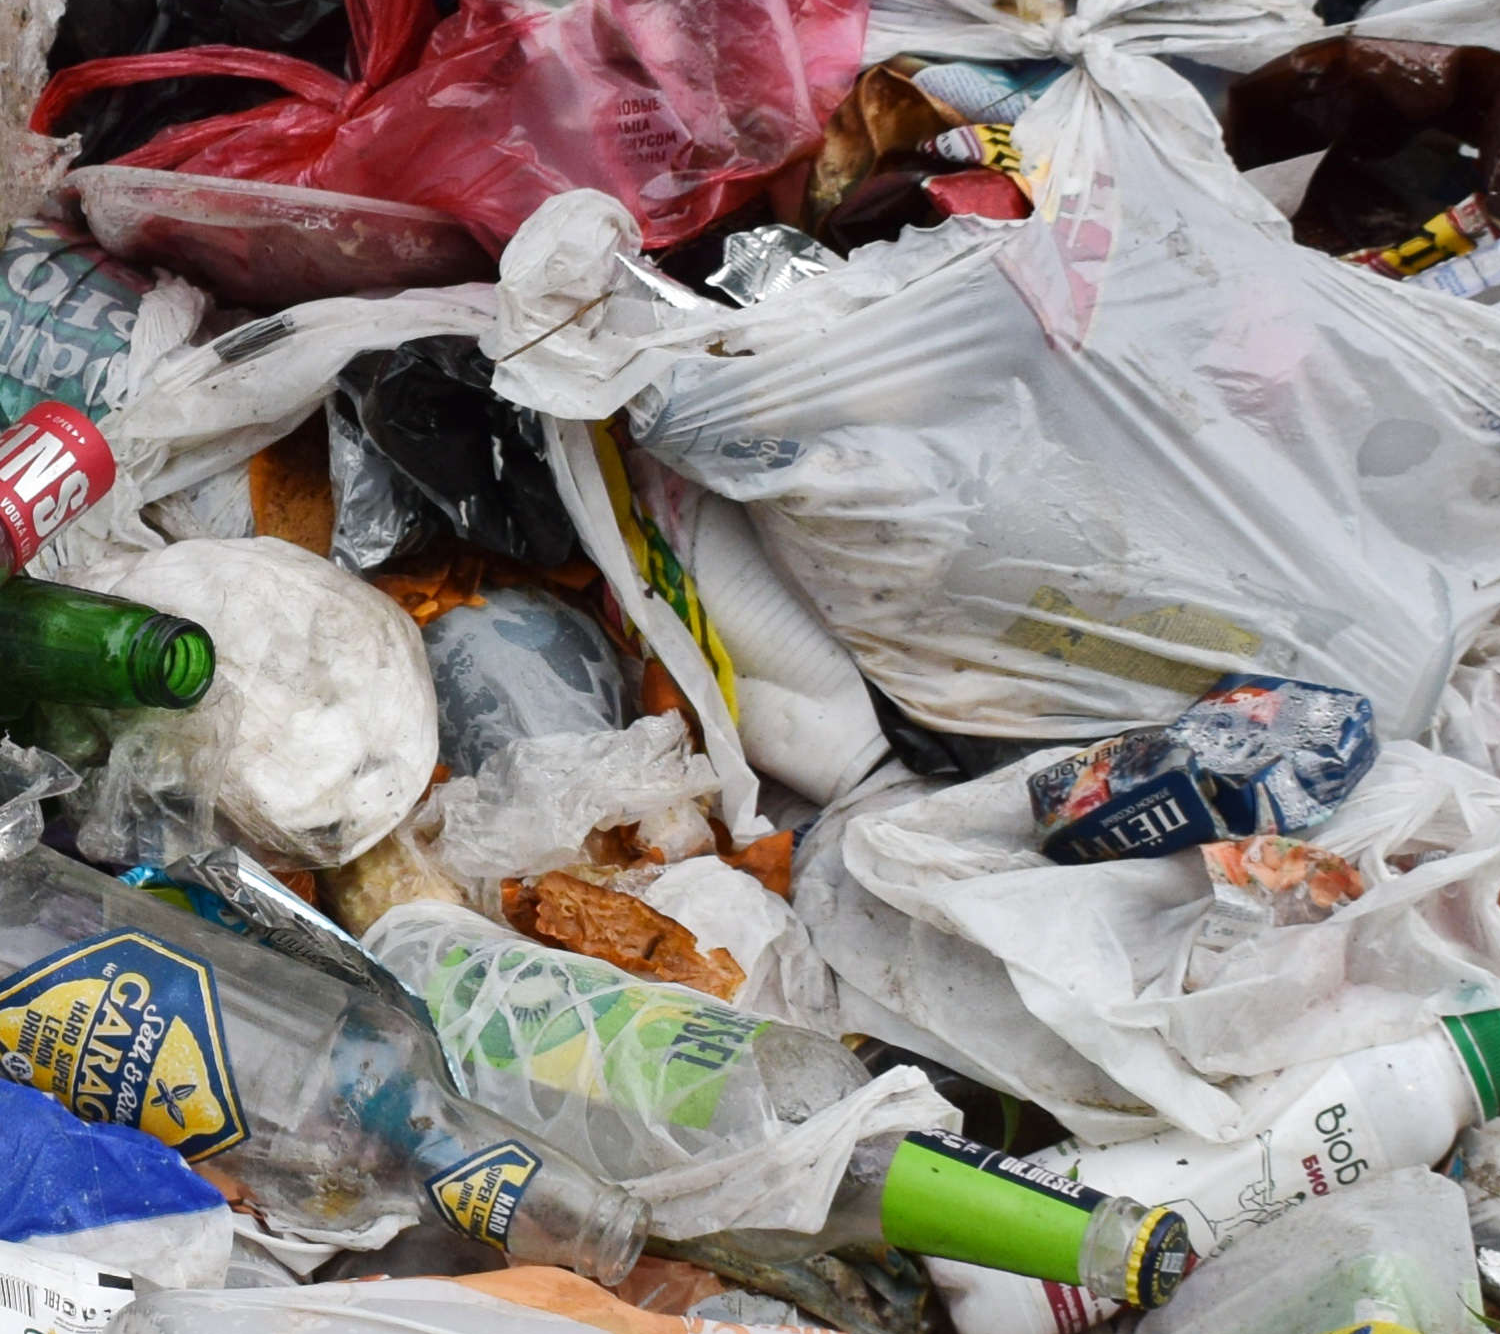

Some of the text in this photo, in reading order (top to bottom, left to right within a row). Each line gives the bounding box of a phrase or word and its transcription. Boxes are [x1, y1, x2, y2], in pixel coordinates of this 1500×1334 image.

[27, 1009, 43, 1055] DRINK
[41, 1017, 61, 1068] LEMON
[56, 1001, 90, 1093] HARD SUPER
[455, 1182, 475, 1214] DRINK
[480, 1163, 504, 1203] SUPER
[491, 1190, 518, 1234] HARD
